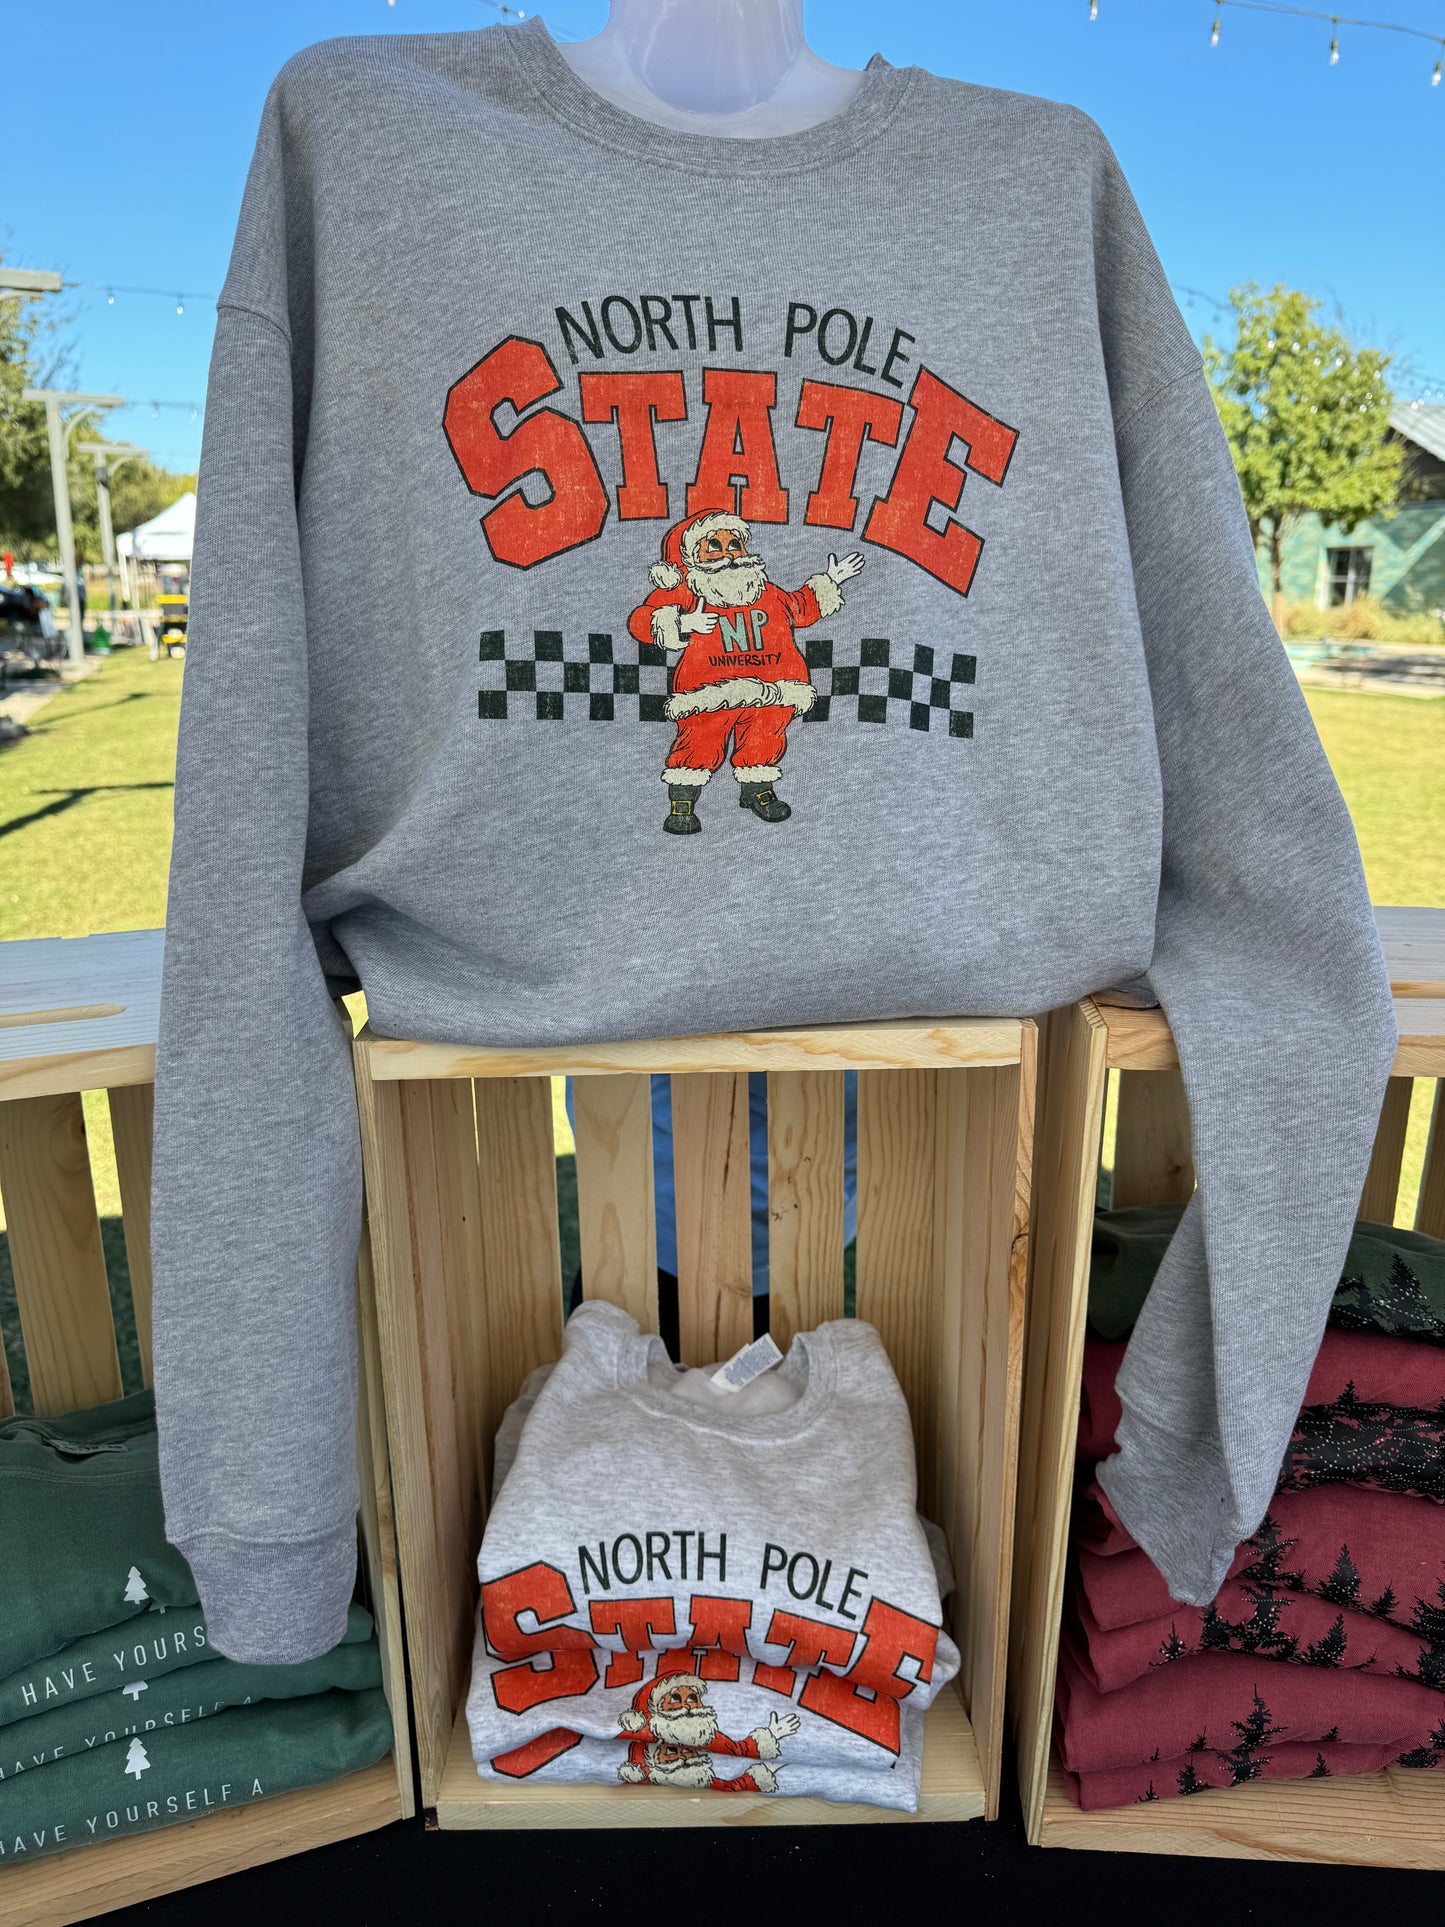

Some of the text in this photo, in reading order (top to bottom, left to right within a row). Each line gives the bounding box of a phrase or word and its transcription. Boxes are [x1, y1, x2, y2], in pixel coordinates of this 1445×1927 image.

[554, 294, 916, 388] NORTH POLE
[442, 334, 1020, 598] STATE
[717, 609, 769, 654] NP
[708, 652, 782, 668] UNIVERSITY
[578, 1530, 869, 1620] NORTH POLE
[21, 1662, 97, 1705] HAVE
[86, 1784, 232, 1834] YOURSELF
[252, 1778, 264, 1796] A
